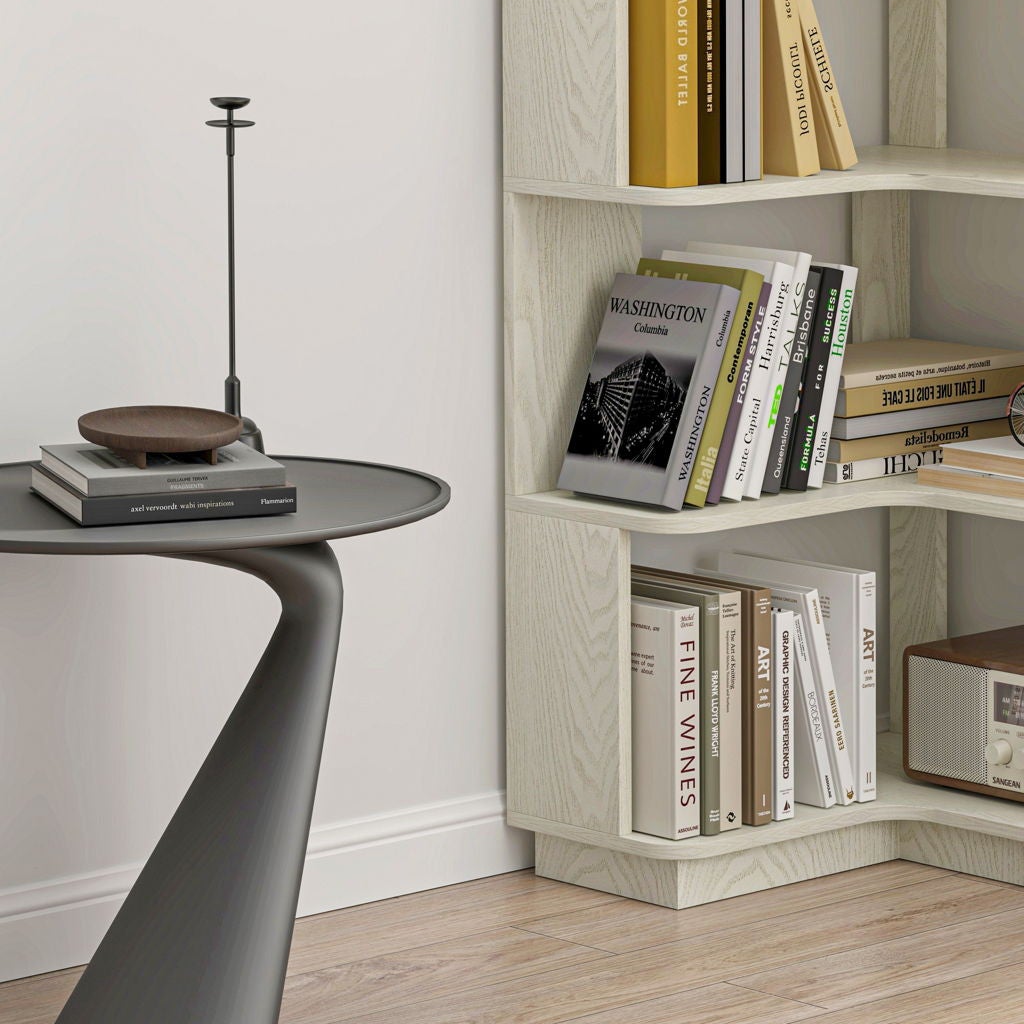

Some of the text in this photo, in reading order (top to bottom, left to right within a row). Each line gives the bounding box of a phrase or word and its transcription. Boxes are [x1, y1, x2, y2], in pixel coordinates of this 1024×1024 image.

[610, 297, 707, 324] WASHINGTON
[634, 322, 669, 336] Columbia
[737, 305, 766, 404] FORM STYLE
[678, 310, 731, 482] WASHINGTON Columbia
[694, 301, 754, 493] Italia Contemporan
[735, 280, 790, 482] State Capital Harrisburg
[767, 383, 783, 429] TED
[773, 288, 816, 478] Queensland Brisbane
[800, 288, 838, 472] FORMULA FOR SUCCESS
[814, 289, 853, 466] Tehas Houston
[145, 503, 178, 512] vervoordt
[197, 500, 235, 509] inspirations
[260, 497, 294, 505] Flammarion
[680, 640, 696, 807] FINE WINES
[992, 776, 1021, 789] SANGEAN
